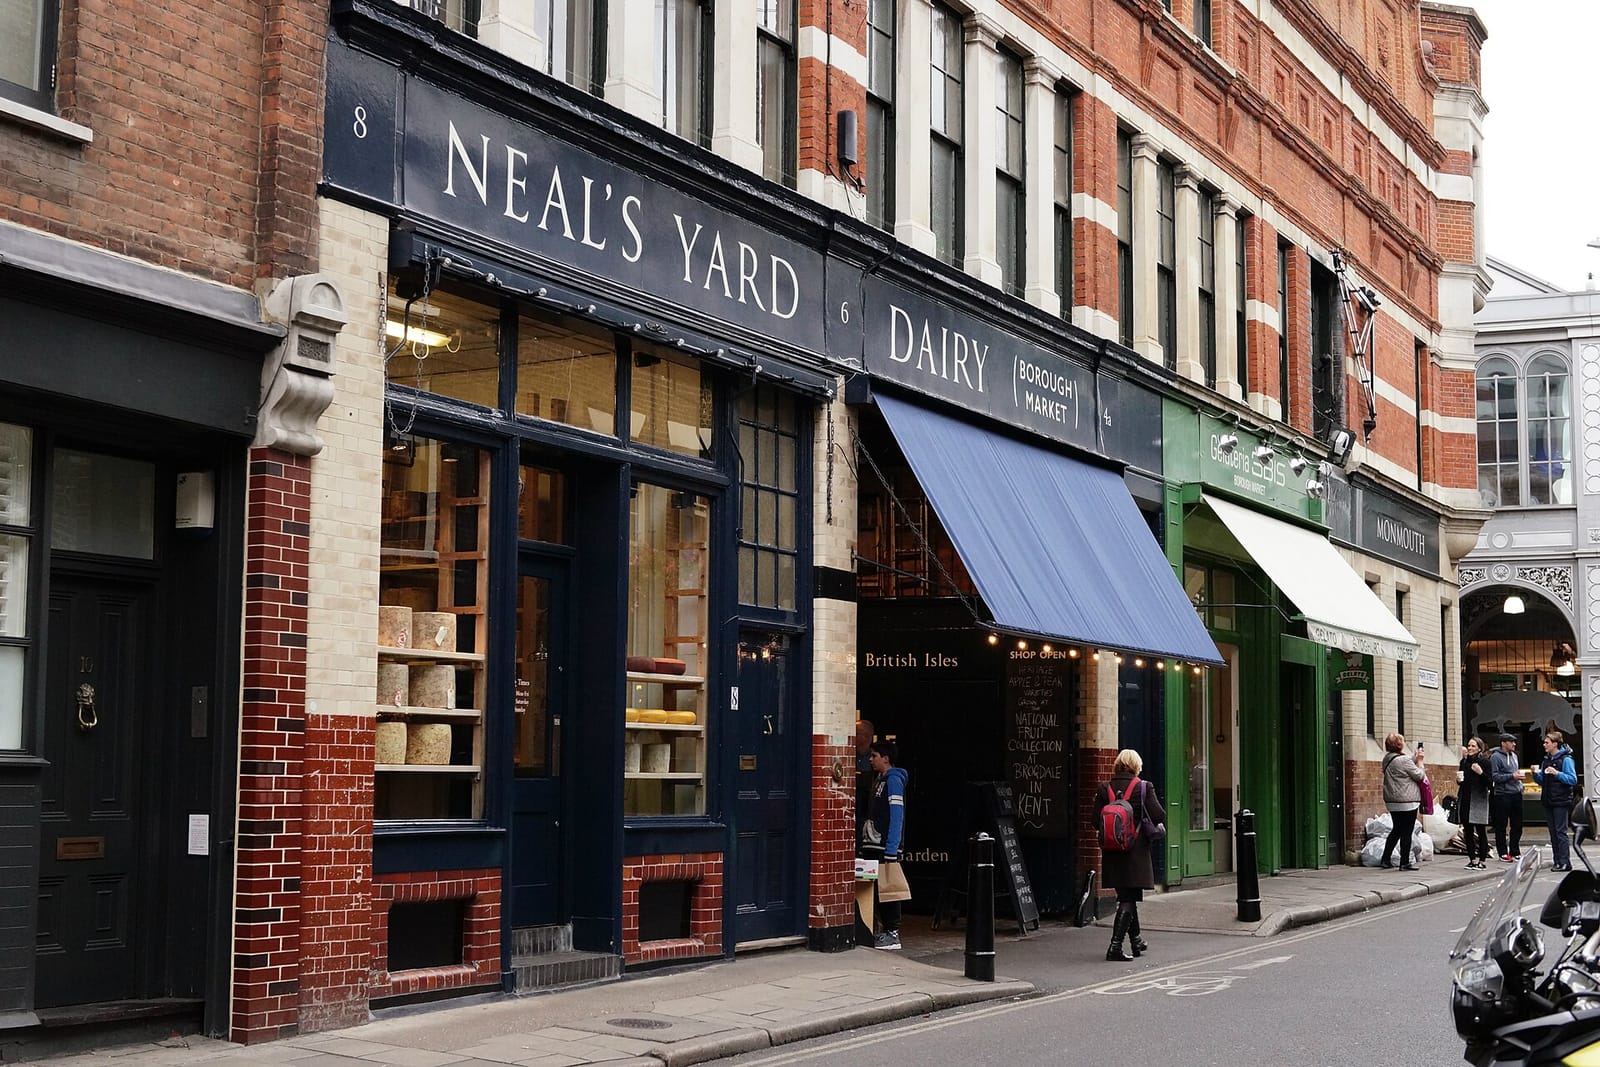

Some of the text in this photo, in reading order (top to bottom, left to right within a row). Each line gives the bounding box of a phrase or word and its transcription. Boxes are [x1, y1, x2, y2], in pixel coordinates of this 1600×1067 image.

[352, 105, 368, 138] 8
[443, 119, 800, 319] NEAL'S YARD
[840, 301, 850, 325] 6
[889, 303, 990, 393] DAIRY
[1019, 359, 1073, 399] BOROUGH
[1025, 390, 1068, 425] MARKET
[1376, 516, 1425, 556] MONMOUTH
[865, 652, 959, 667] British Isles
[1009, 650, 1067, 660] SHOP OPEN
[1015, 712, 1060, 727] NATIONAL
[1018, 726, 1049, 740] FRUIT
[1007, 739, 1063, 752] COLLECTION
[1027, 752, 1039, 765] AT
[1013, 762, 1063, 780] BROGDALE
[1030, 780, 1042, 794] IN
[1017, 792, 1052, 819] KENT
